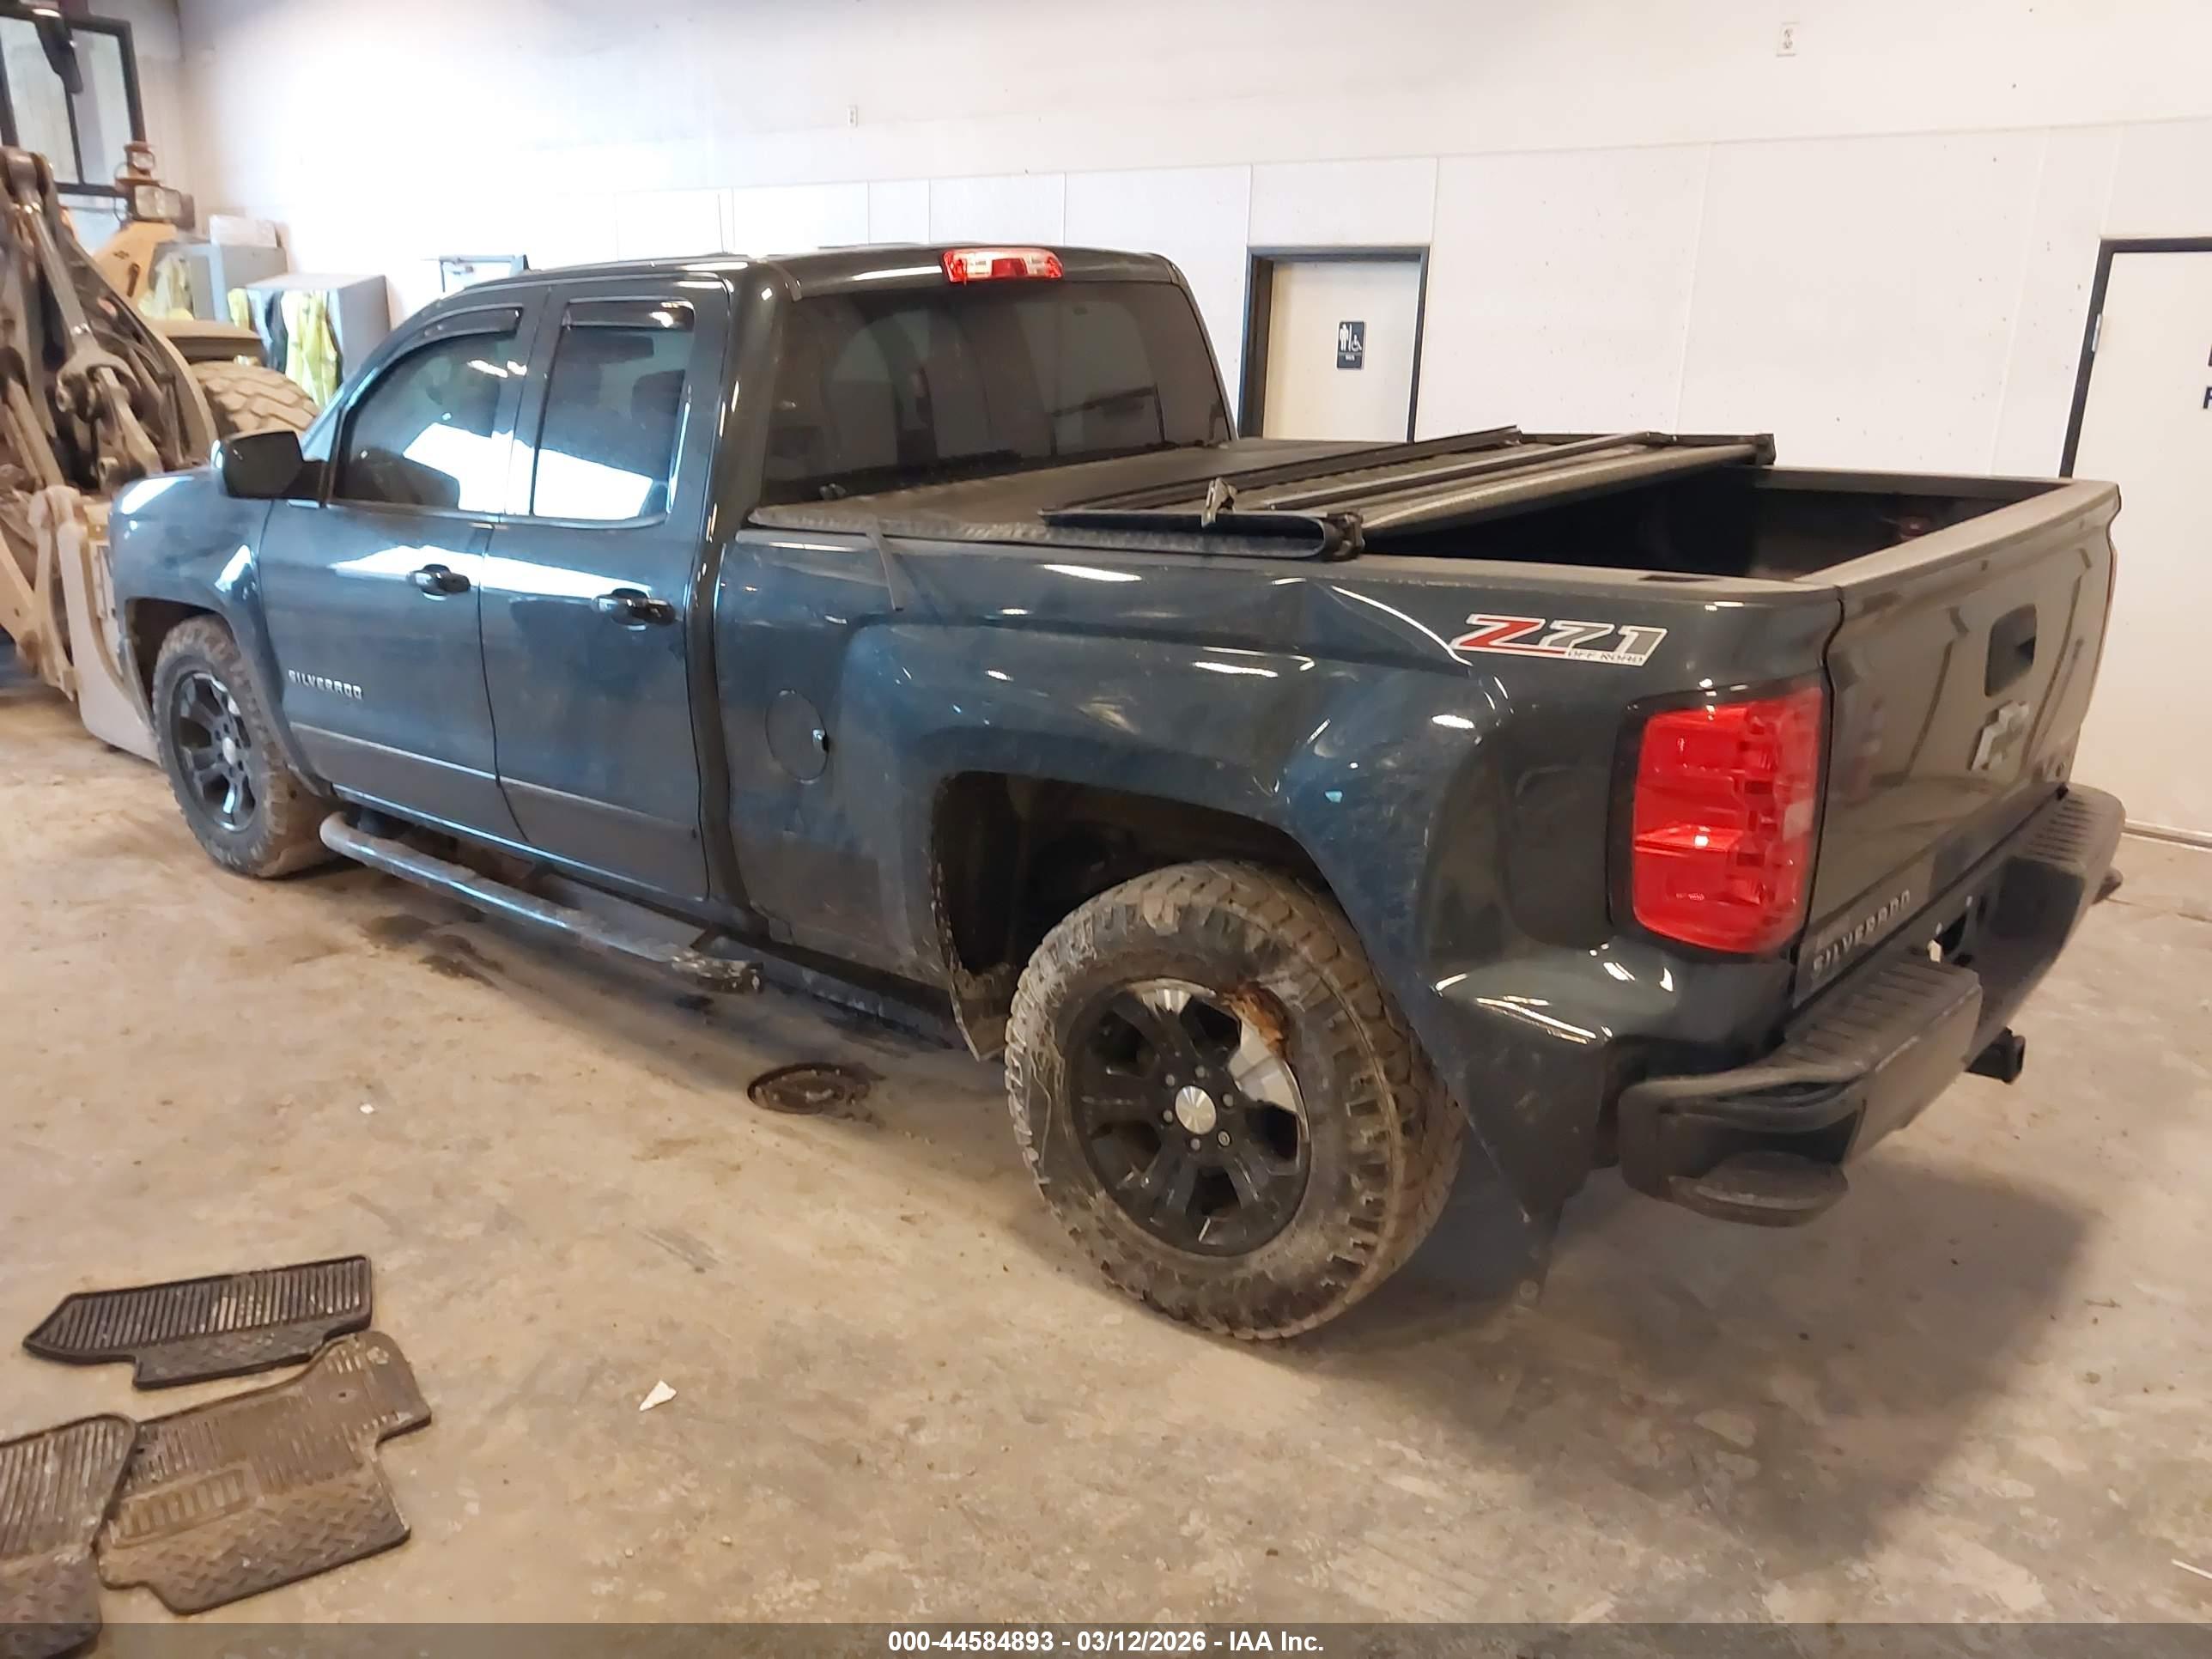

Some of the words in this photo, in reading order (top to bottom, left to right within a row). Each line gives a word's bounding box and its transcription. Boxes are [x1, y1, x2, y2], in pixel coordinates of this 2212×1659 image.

[1449, 613, 1668, 665] Z71
[288, 669, 363, 700] SILVERADO
[1811, 889, 1911, 977] SILVERADO
